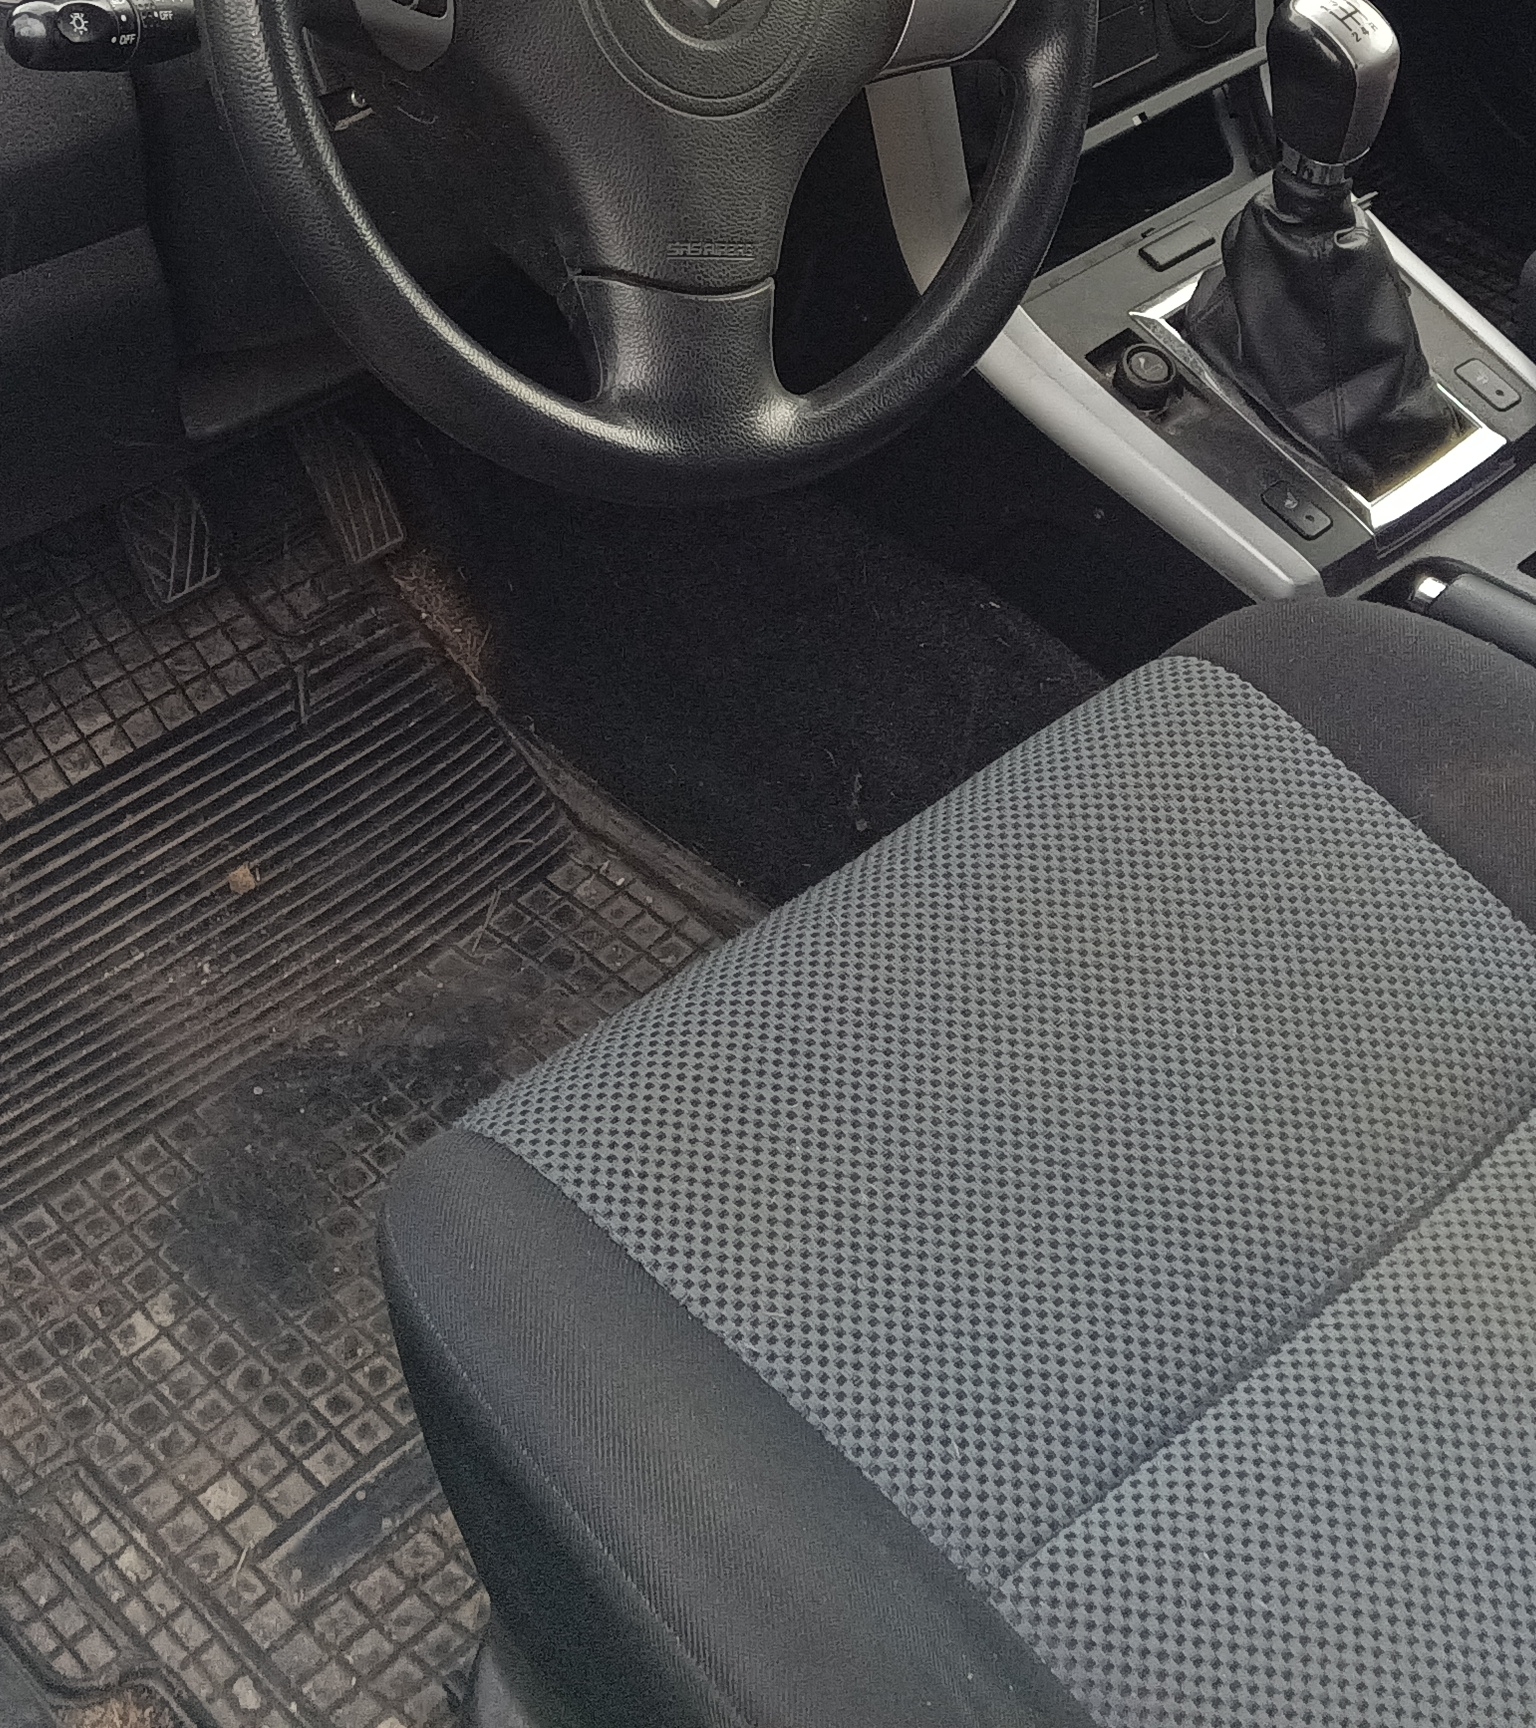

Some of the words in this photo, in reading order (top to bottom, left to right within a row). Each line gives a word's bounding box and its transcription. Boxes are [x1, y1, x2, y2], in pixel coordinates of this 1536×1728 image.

[159, 10, 173, 21] OFF
[119, 33, 136, 46] OFF
[1351, 31, 1362, 43] 2
